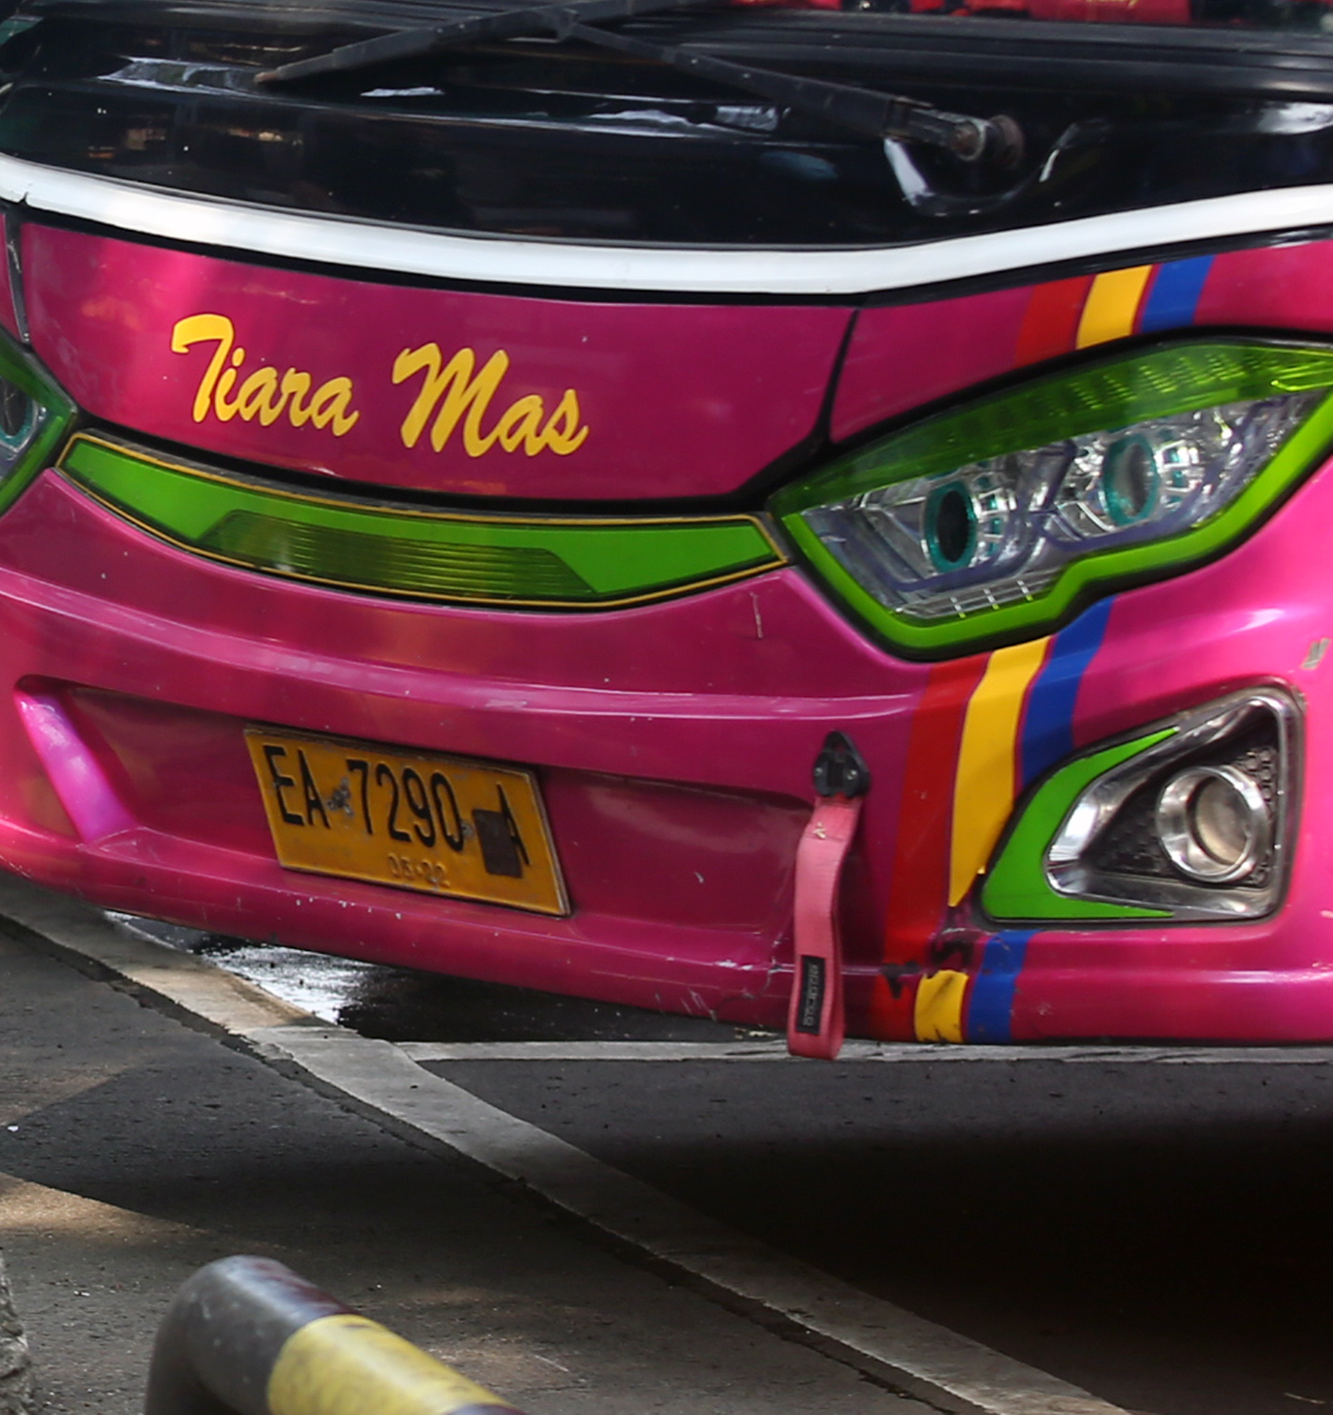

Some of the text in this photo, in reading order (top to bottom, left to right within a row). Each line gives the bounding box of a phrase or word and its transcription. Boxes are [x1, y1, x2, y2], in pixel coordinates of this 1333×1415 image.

[171, 314, 589, 458] Tiara Mas
[262, 744, 331, 830] EA
[345, 757, 465, 853] 7290
